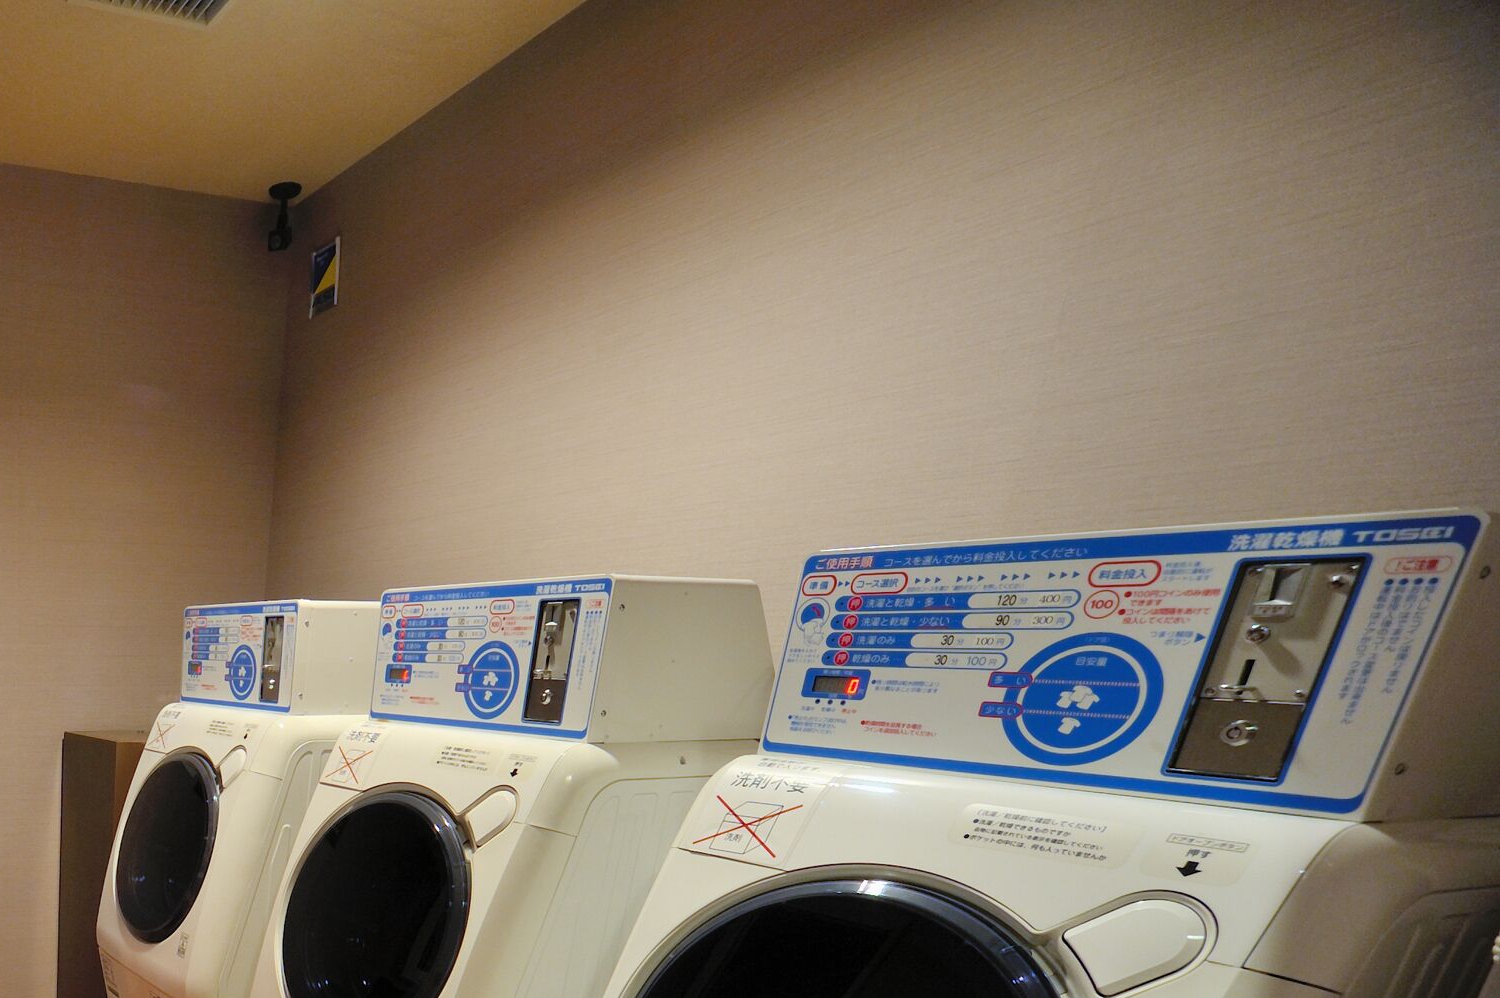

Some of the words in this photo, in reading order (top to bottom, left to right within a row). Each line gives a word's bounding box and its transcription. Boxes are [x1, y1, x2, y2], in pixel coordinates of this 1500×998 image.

[1228, 529, 1345, 550] 洗濯乾燥機
[1352, 526, 1455, 542] TOSEI
[815, 555, 874, 570] ご使用手順
[1098, 568, 1148, 580] 料金投入
[856, 578, 899, 589] コース選択
[1090, 600, 1113, 609] 100
[847, 678, 860, 695] 0
[723, 831, 742, 844] 洗剤
